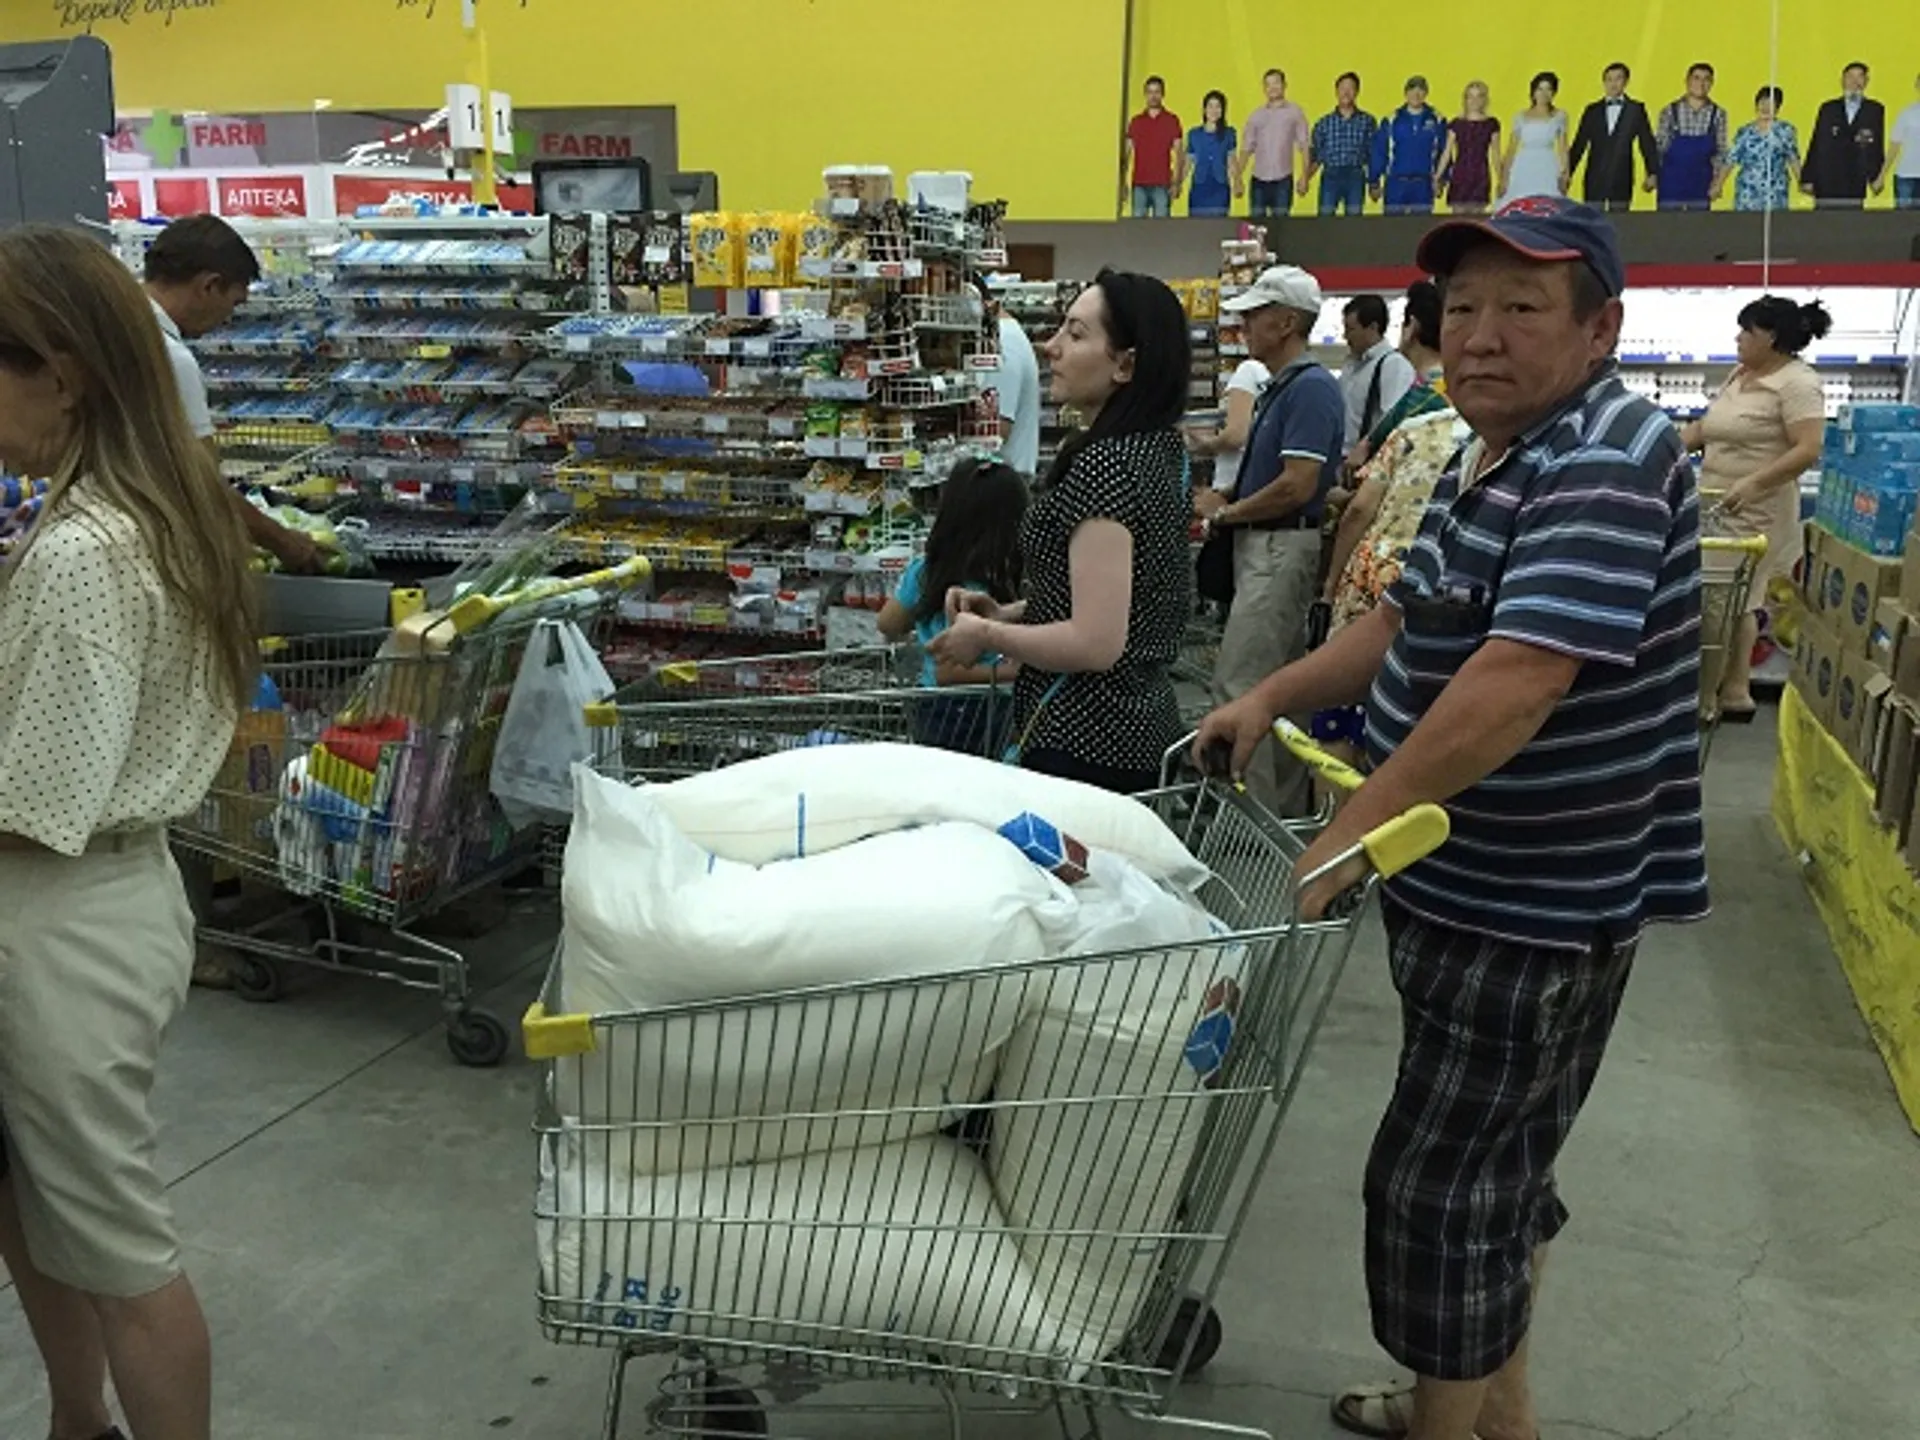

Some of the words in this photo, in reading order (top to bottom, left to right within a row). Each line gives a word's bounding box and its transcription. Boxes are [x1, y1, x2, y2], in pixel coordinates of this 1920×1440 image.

[194, 124, 266, 146] FARM
[541, 133, 631, 156] FARM
[227, 188, 299, 207] АПТЕКА
